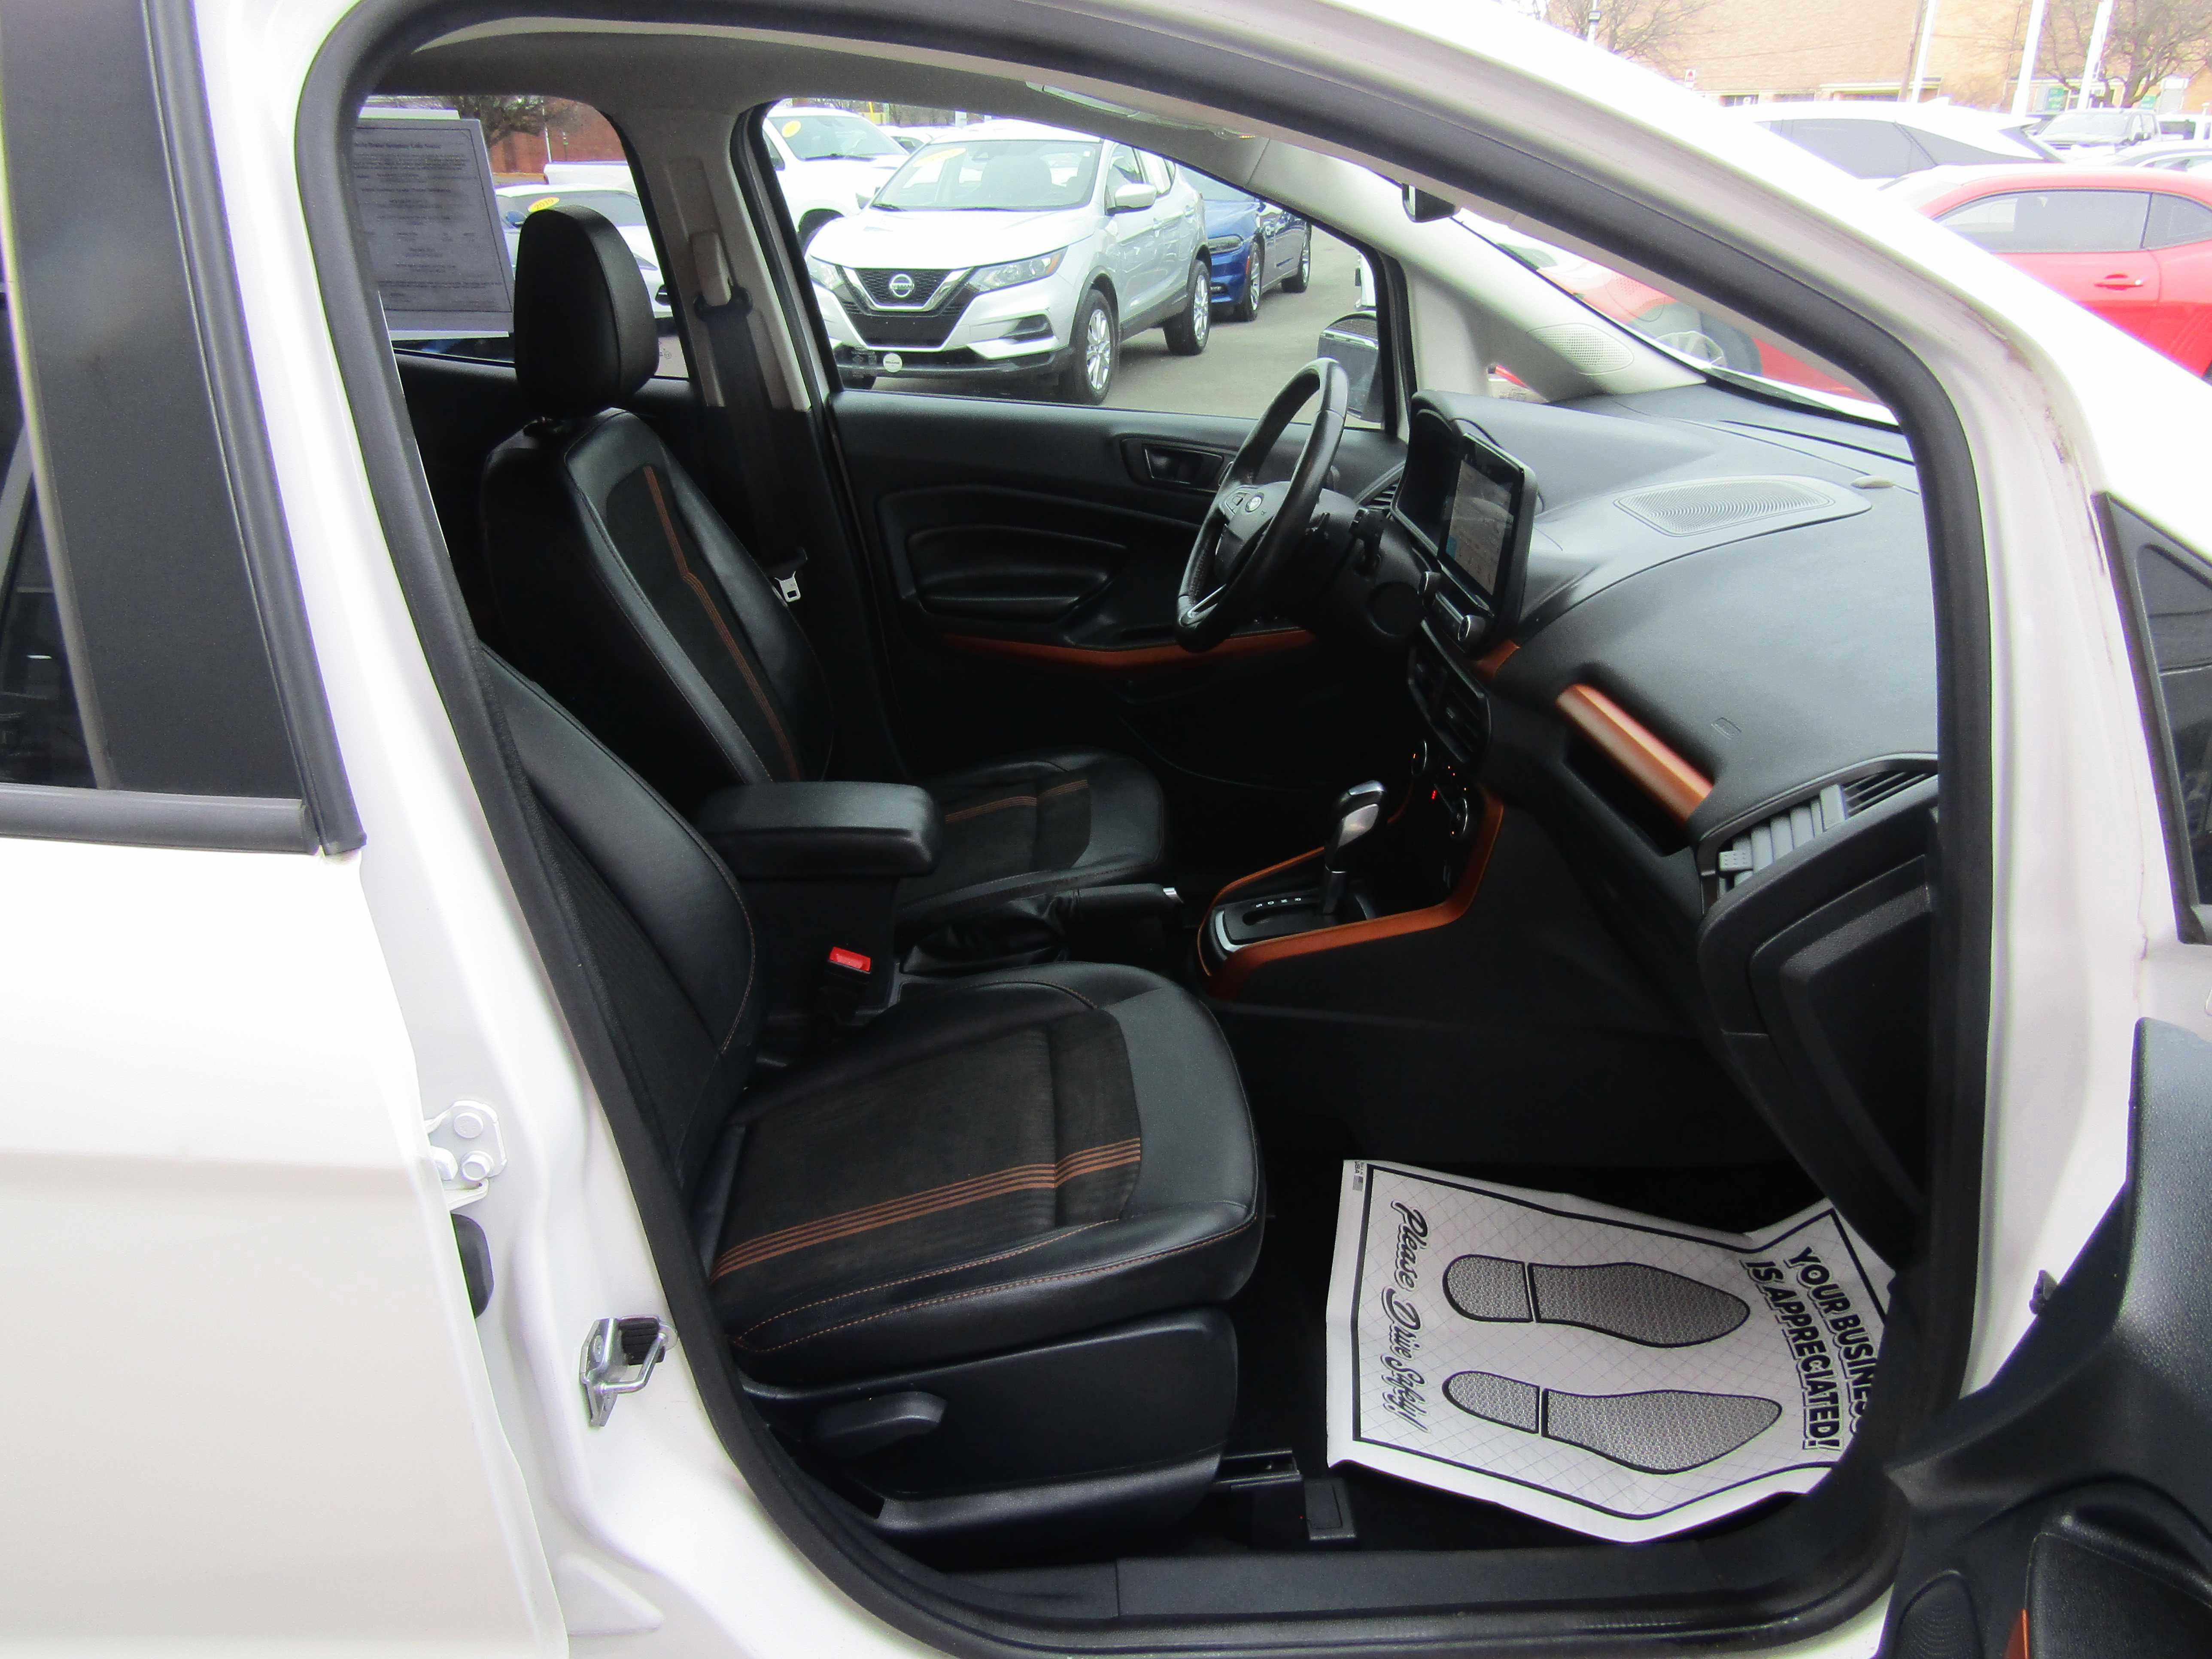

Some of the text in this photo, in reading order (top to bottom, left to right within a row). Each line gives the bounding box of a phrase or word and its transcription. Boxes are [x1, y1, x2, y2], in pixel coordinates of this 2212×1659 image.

[534, 198, 554, 210] 2019
[1381, 1200, 1430, 1433] Please Drive Safely!
[1742, 1260, 1841, 1449] IS APPRECIATED!
[1786, 1246, 1878, 1433] YOUR BUSIN
